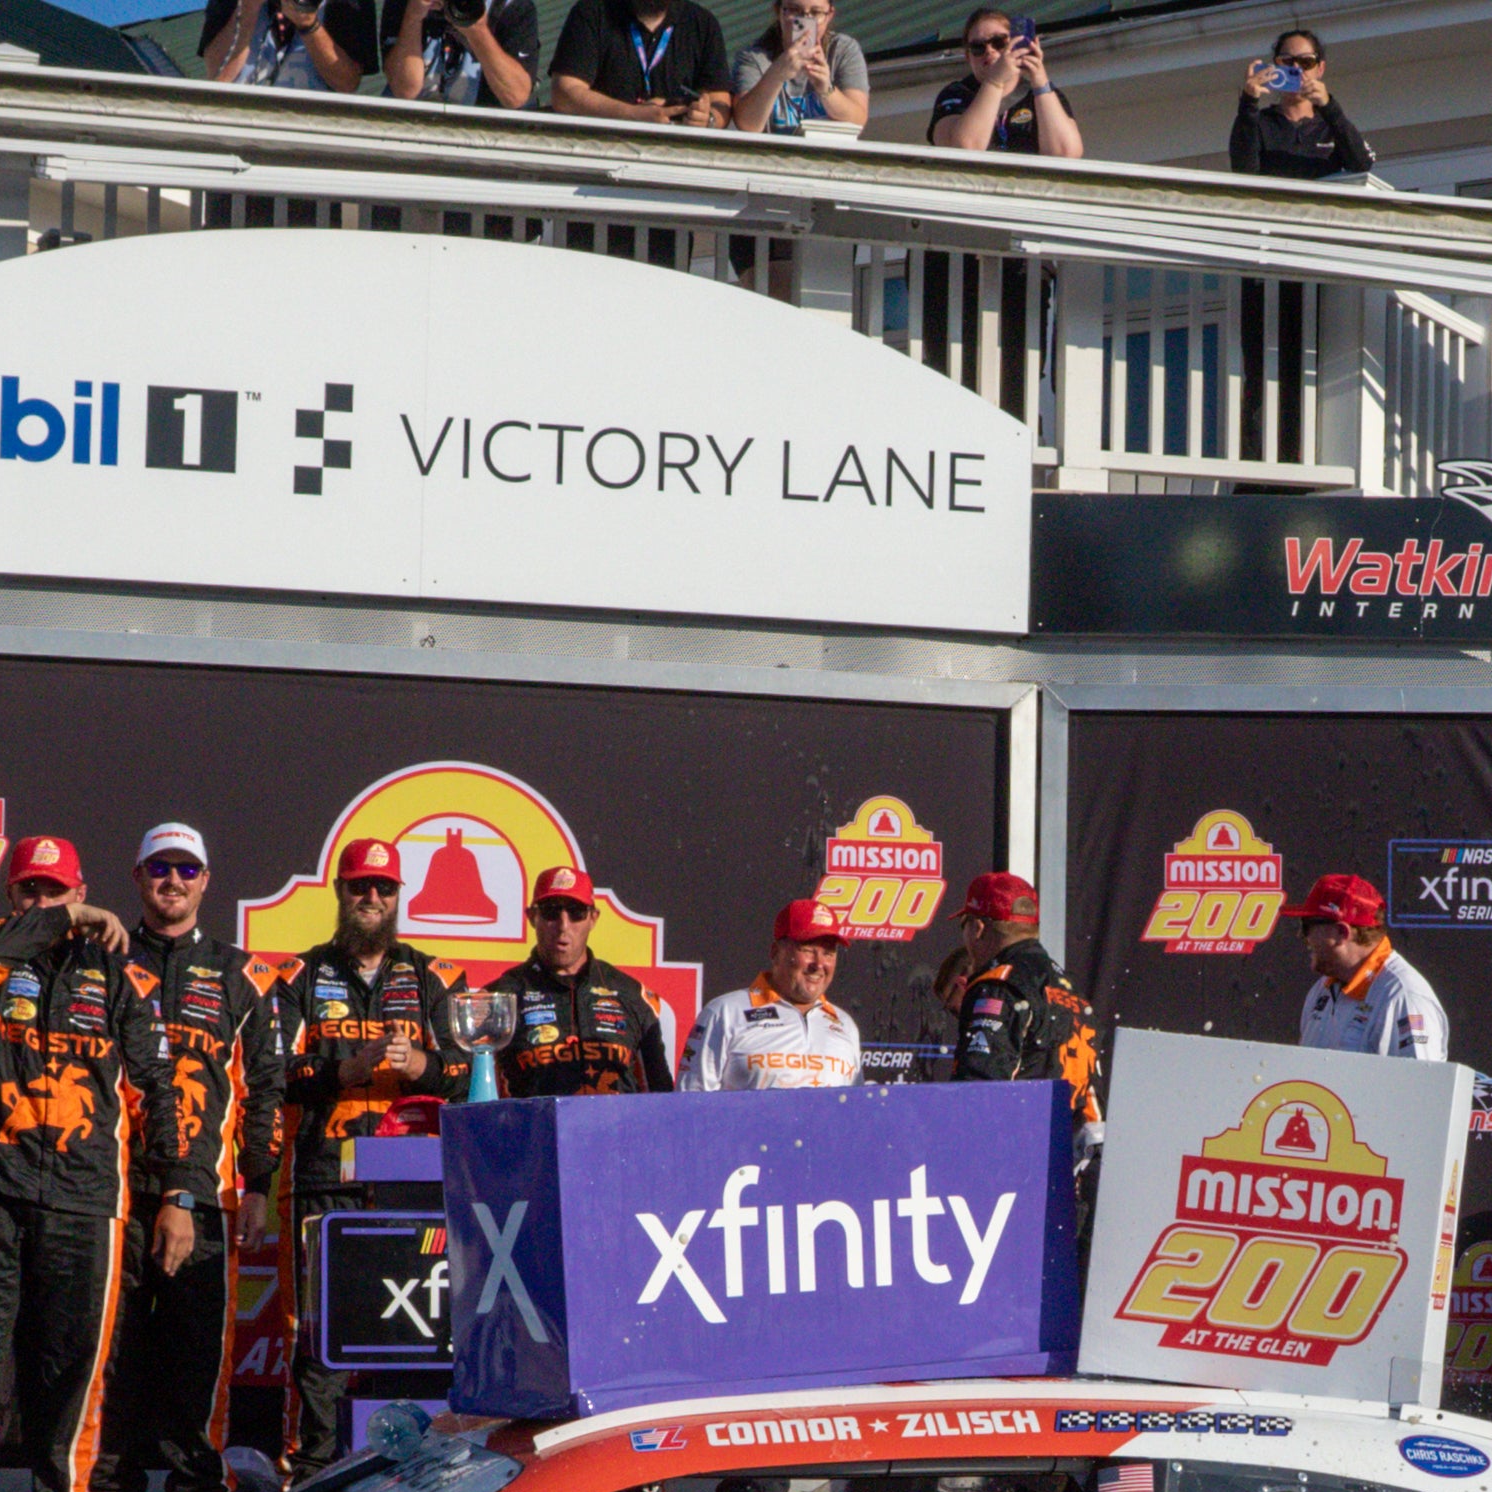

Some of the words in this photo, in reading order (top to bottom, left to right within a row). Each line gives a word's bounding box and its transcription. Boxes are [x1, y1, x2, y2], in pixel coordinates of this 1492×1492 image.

[400, 411, 753, 498] VICTORY
[781, 438, 987, 514] LANE
[854, 926, 874, 938] THE
[876, 928, 905, 939] GLEN
[1145, 891, 1284, 940] 200
[1176, 940, 1194, 951] AT
[1195, 940, 1214, 951] THE
[1216, 940, 1245, 953] GLEN
[747, 1052, 857, 1077] REGISTIX
[635, 1164, 1017, 1324] xfinity
[1122, 1227, 1404, 1341] 200
[1181, 1328, 1211, 1345] AT
[1214, 1332, 1255, 1352] THE
[1258, 1338, 1312, 1359] GLEN
[705, 1415, 862, 1447] CONNOR
[895, 1410, 1042, 1439] ZILISCH
[1406, 1447, 1438, 1461] CHRIS
[1439, 1449, 1487, 1467] RASCHKE
